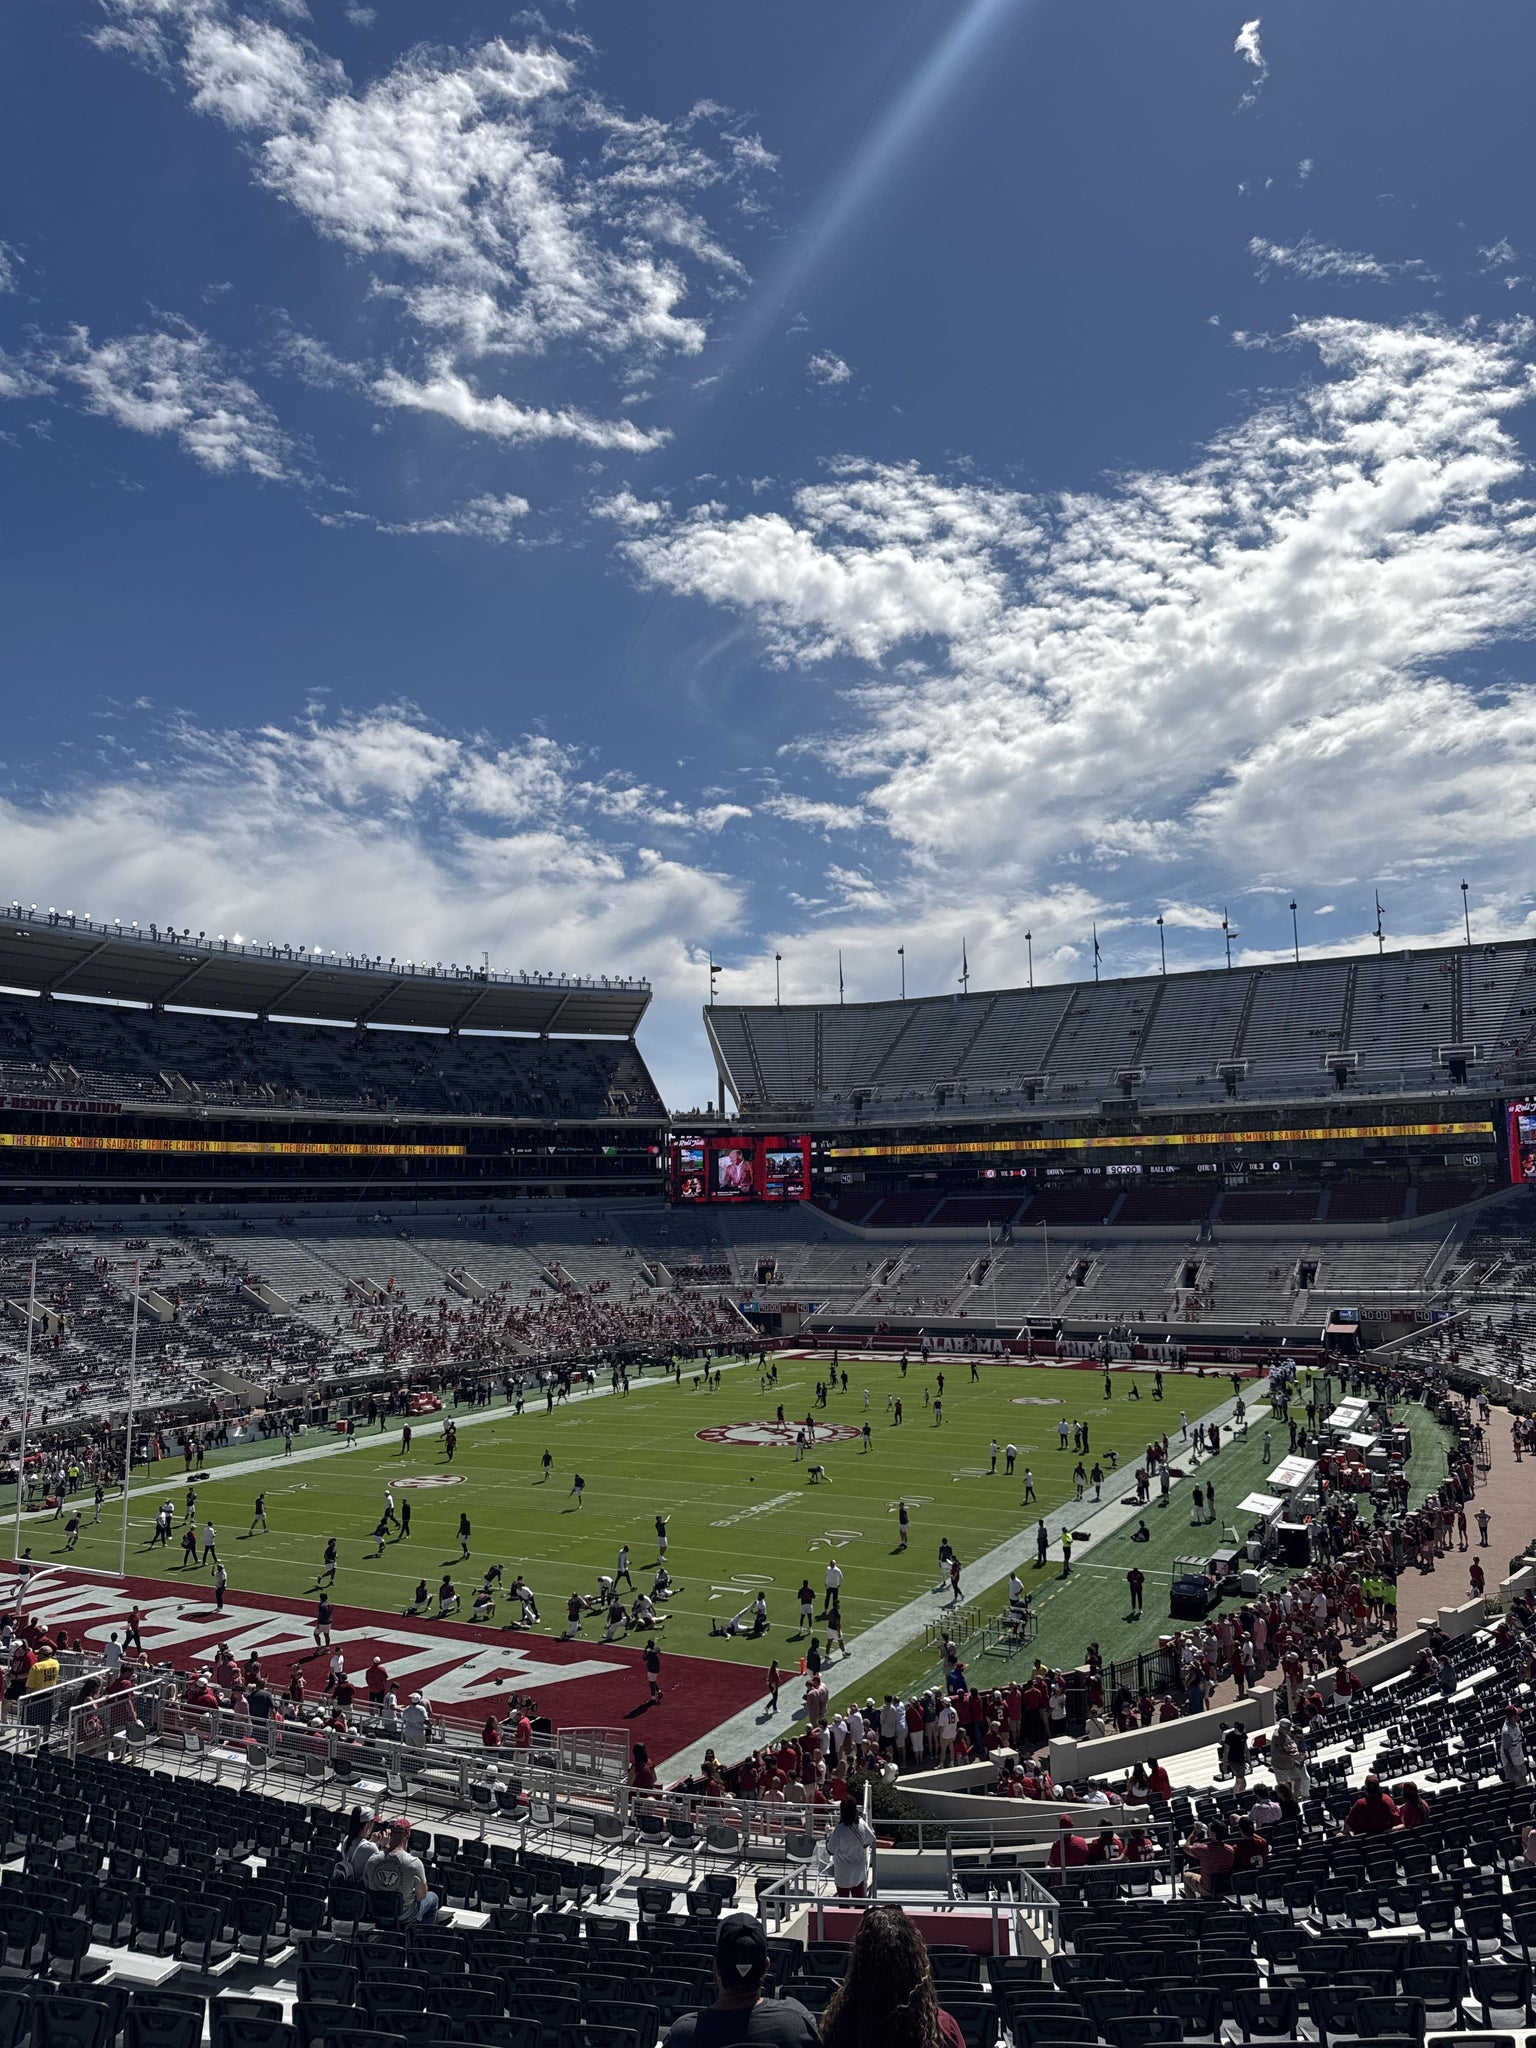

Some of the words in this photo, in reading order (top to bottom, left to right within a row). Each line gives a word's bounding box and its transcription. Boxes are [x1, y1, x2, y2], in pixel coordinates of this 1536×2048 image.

[61, 1100, 121, 1113] STADIUM
[1182, 1135, 1196, 1144] THE
[1200, 1133, 1236, 1143] OFFICIAL
[1240, 1131, 1274, 1141] SMOKED
[1278, 1129, 1318, 1140] SAUSAGE
[1322, 1129, 1333, 1138] OF
[1337, 1128, 1352, 1138] THE
[12, 1135, 27, 1146] THE
[30, 1136, 67, 1147] OFFICIAL
[70, 1137, 104, 1148] SMOKED
[106, 1138, 143, 1149] SAUSAGE
[146, 1140, 155, 1150] OF
[159, 1140, 173, 1150] THE
[176, 1140, 210, 1151] CRIMSON
[280, 1142, 293, 1152] THE
[296, 1143, 327, 1153] OFFICIAL
[328, 1144, 358, 1153] SMOKED
[360, 1144, 391, 1154] SAUSAGE
[394, 1145, 402, 1154] OF
[404, 1145, 416, 1154] THE
[418, 1145, 449, 1154] CRIMSON
[876, 1147, 888, 1155] THE
[890, 1145, 921, 1154] OFFICIAL
[922, 1144, 953, 1153] SMOKED
[954, 1142, 985, 1152] SAUSAGE
[987, 1142, 996, 1151] OF
[999, 1141, 1012, 1150] THE
[1015, 1140, 1048, 1149] CRIMSON
[1272, 1162, 1280, 1171] 0
[1465, 1156, 1478, 1165] 40
[1020, 1168, 1027, 1177] 0
[1111, 1165, 1138, 1174] 90:00
[1150, 1165, 1165, 1173] BALL
[842, 1174, 852, 1182] 40
[1361, 1310, 1389, 1320] 90:00
[1416, 1311, 1430, 1321] 40
[921, 1337, 1004, 1353] ALABAMA
[803, 1352, 1080, 1368] CRIMSON
[806, 1529, 864, 1549] 20
[710, 1573, 775, 1597] 10
[948, 1712, 955, 1724] 18
[997, 1709, 1004, 1720] 2
[1103, 1844, 1120, 1859] 15
